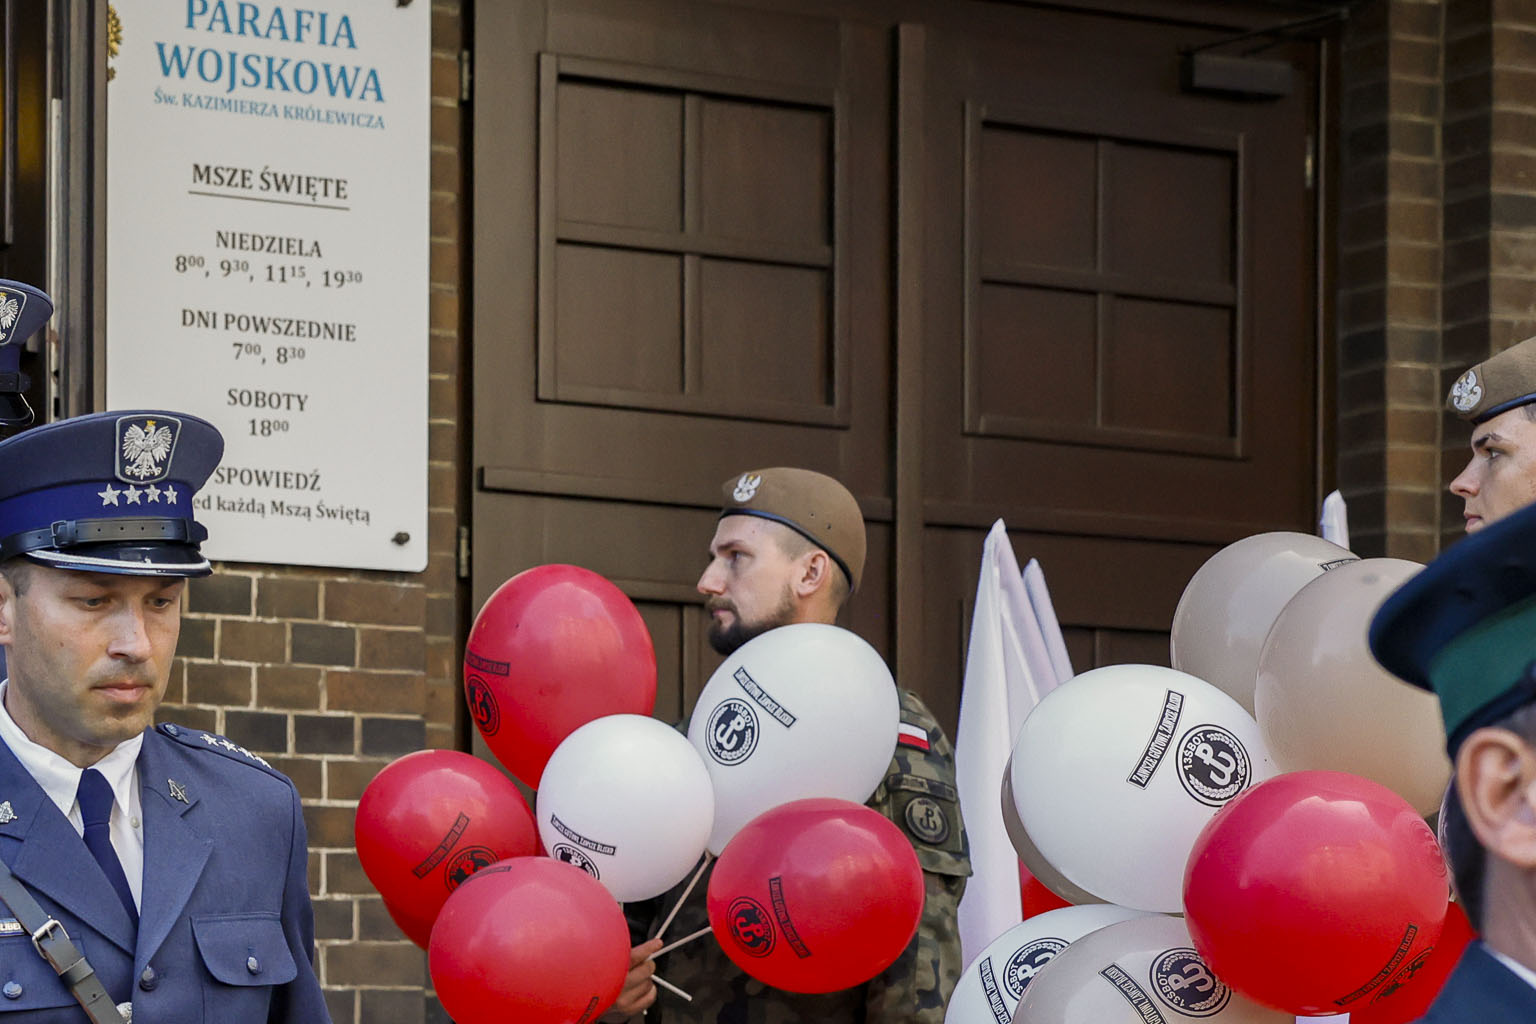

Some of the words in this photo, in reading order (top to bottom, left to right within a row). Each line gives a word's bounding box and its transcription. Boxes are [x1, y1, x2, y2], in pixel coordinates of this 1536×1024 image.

[185, 0, 358, 49] PARAFIA
[154, 42, 385, 103] WOJSKOWA
[182, 93, 280, 118] KAZIMIERZA
[283, 104, 386, 130] KRÓLEWICZA
[192, 163, 254, 190] MSZE
[259, 165, 349, 202] ŚWIĘTE
[215, 230, 323, 258] NIEDZIELA
[182, 309, 217, 329] DNI
[224, 313, 357, 342] POWSZEDNIE
[227, 388, 309, 412] SOBOTY
[215, 466, 322, 492] SPOWIEDŹ
[217, 496, 266, 518] każdą
[271, 500, 311, 521] Mszą
[316, 501, 371, 525] Świętą
